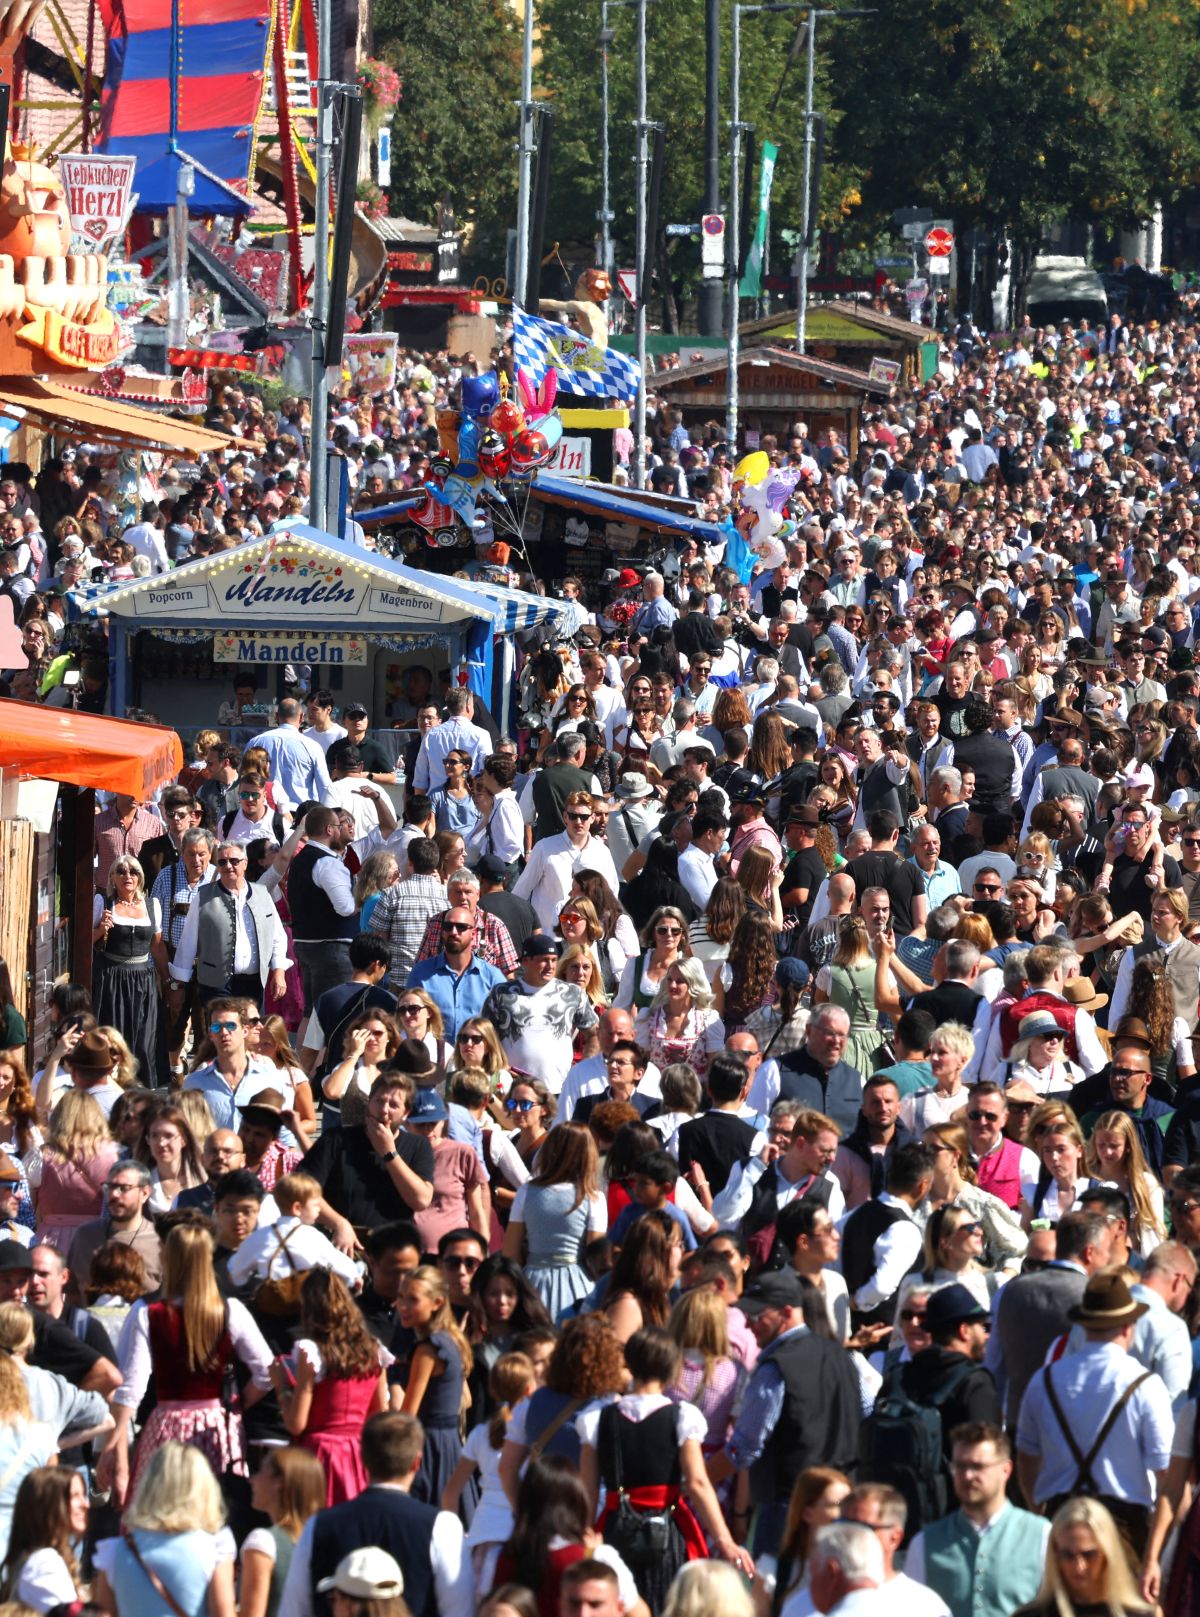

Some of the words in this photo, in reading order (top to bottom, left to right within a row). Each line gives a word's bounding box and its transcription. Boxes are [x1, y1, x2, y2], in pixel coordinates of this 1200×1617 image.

[66, 163, 128, 187] Lebkuchen
[69, 186, 123, 217] Herzl
[149, 590, 193, 604] Popcorn
[225, 575, 355, 607] Mandeln
[379, 592, 433, 610] Magenbrot
[237, 639, 344, 663] Mandeln
